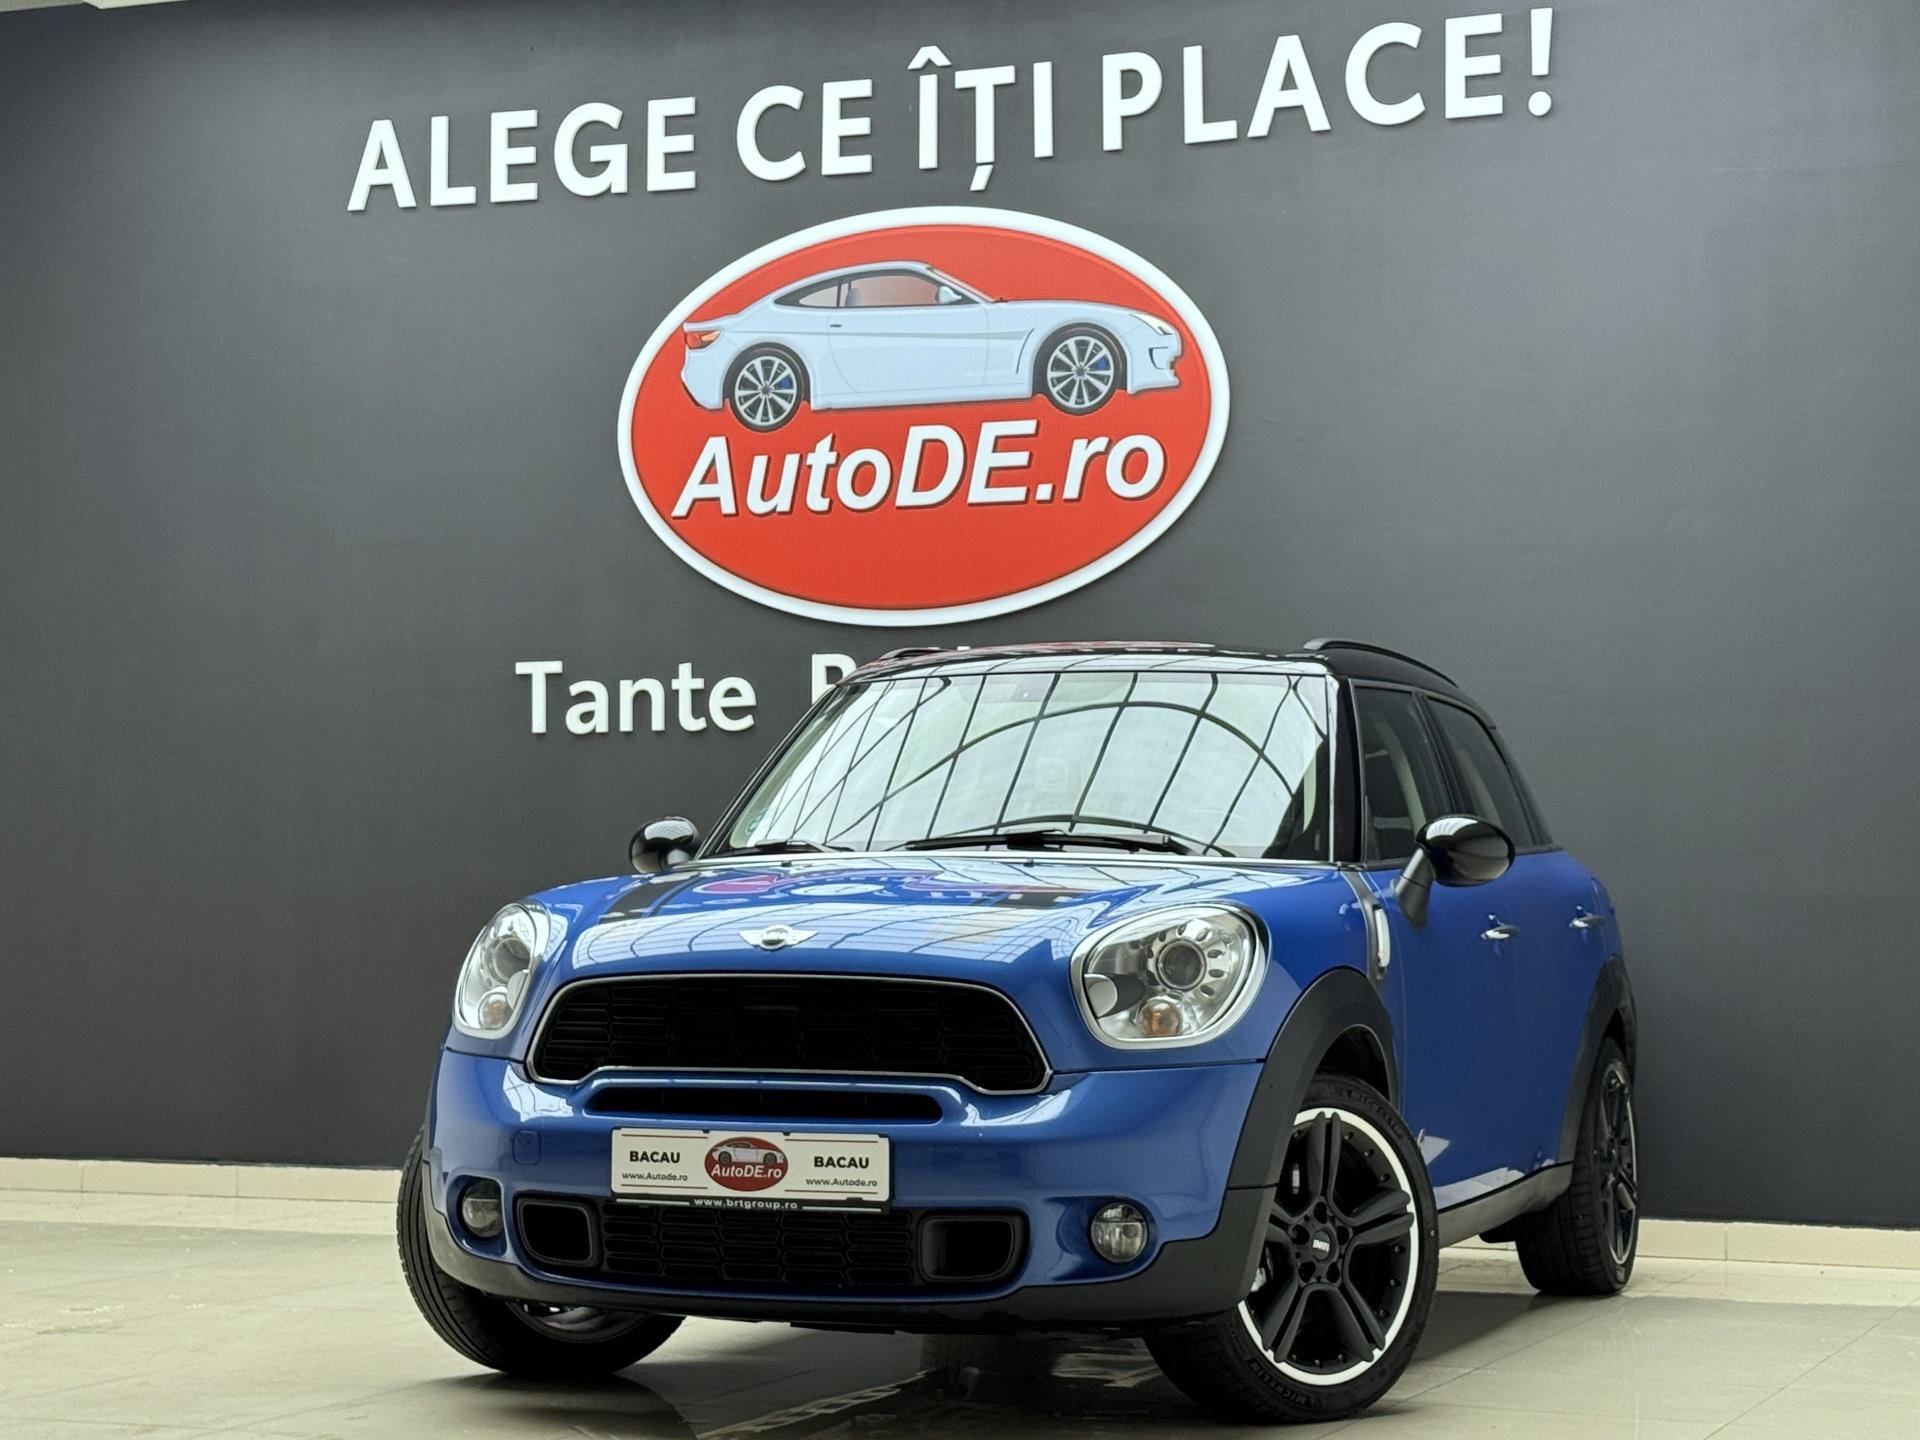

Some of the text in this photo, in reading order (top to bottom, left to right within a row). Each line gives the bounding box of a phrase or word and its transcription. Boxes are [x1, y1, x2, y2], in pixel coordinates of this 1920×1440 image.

[346, 96, 697, 212] ALEGE
[736, 79, 874, 182] CE
[1102, 6, 1555, 153] PLACE!
[671, 419, 1166, 519] AutoDE.ro
[514, 660, 758, 736] Tante
[629, 1150, 681, 1164] BACAU
[813, 1155, 870, 1169] BACAU
[621, 1171, 689, 1182] www.Autode.ro
[710, 1163, 783, 1179] AutoDE.ro
[805, 1177, 878, 1188] www.Autode.ro
[693, 1198, 799, 1211] www.brtgroup.ro
